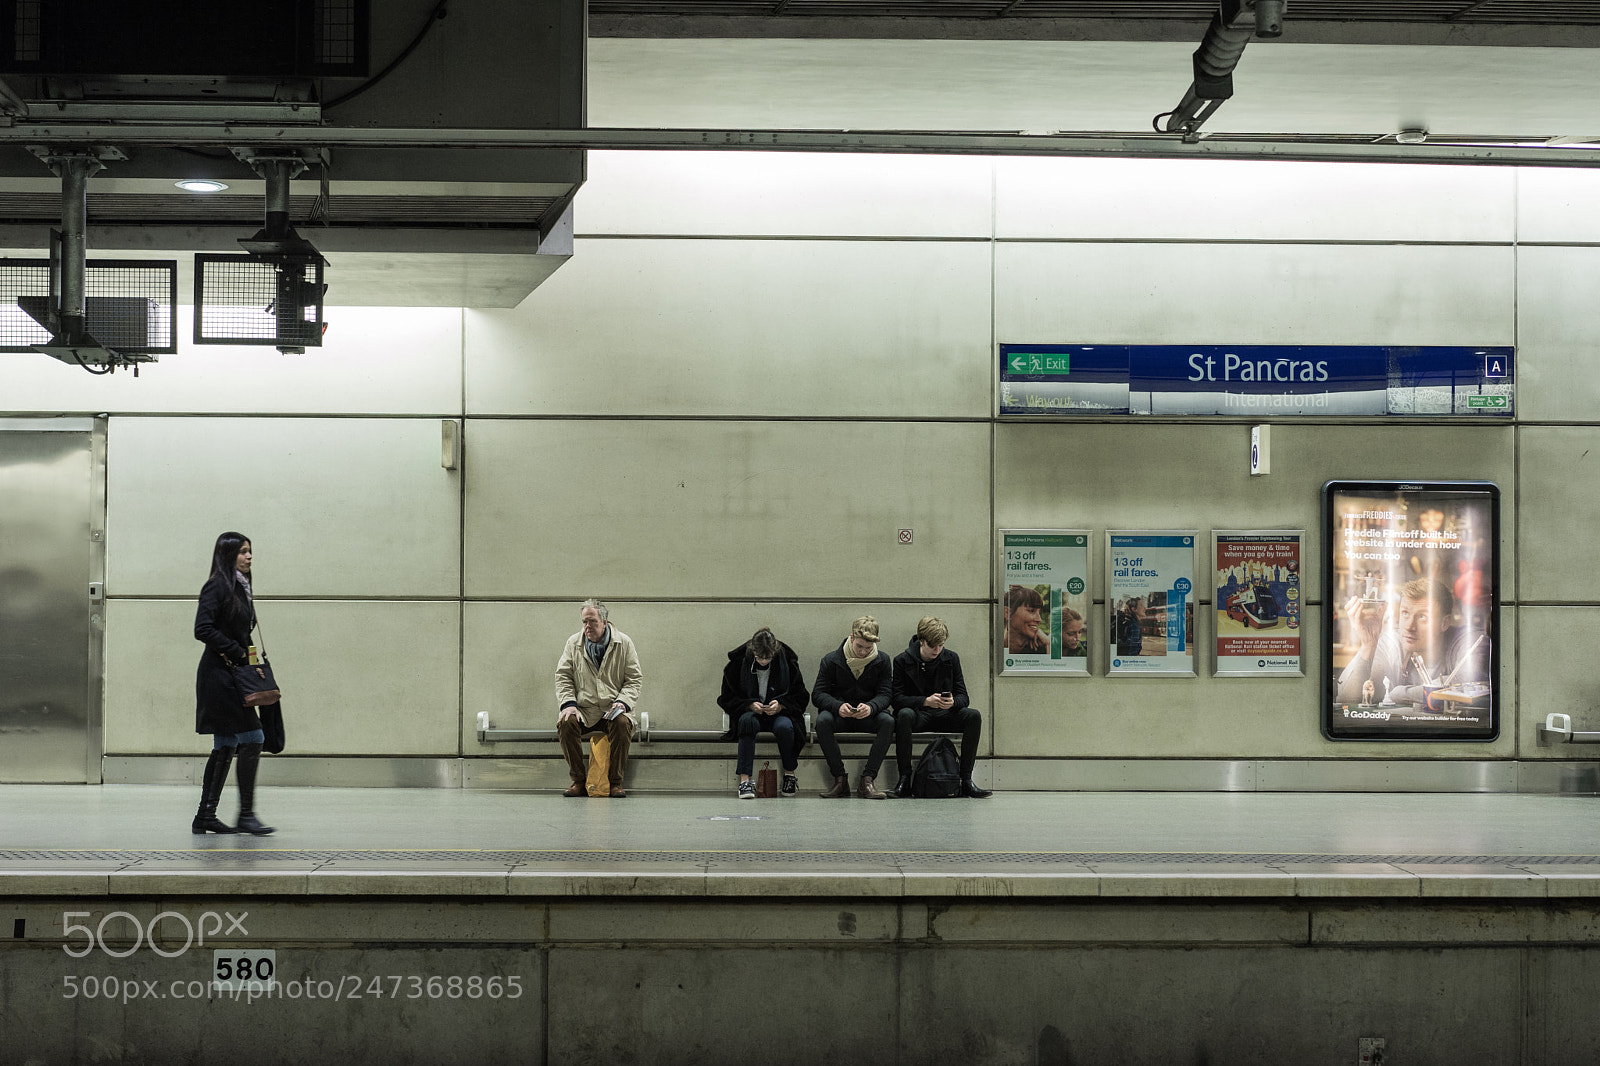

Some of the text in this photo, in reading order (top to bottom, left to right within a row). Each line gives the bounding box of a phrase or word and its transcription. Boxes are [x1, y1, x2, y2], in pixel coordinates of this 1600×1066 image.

[1046, 358, 1066, 369] Exit
[1188, 353, 1329, 382] St Pancras
[1492, 360, 1501, 372] A
[1026, 394, 1071, 409] Way out
[1224, 390, 1329, 407] International
[1344, 528, 1381, 538] Freddie
[1420, 530, 1442, 539] built
[1443, 530, 1457, 540] his
[1344, 538, 1384, 547] website
[1395, 540, 1424, 549] under
[1425, 541, 1438, 549] an
[1439, 540, 1461, 550] hour
[1022, 551, 1036, 560] off
[1266, 551, 1275, 559] by
[1344, 550, 1401, 560] You can too
[1007, 562, 1052, 571] rail fares.
[1129, 557, 1143, 567] off
[1114, 568, 1159, 577] rail fares.
[1350, 711, 1391, 721] GoDaddy
[215, 956, 274, 981] 580
